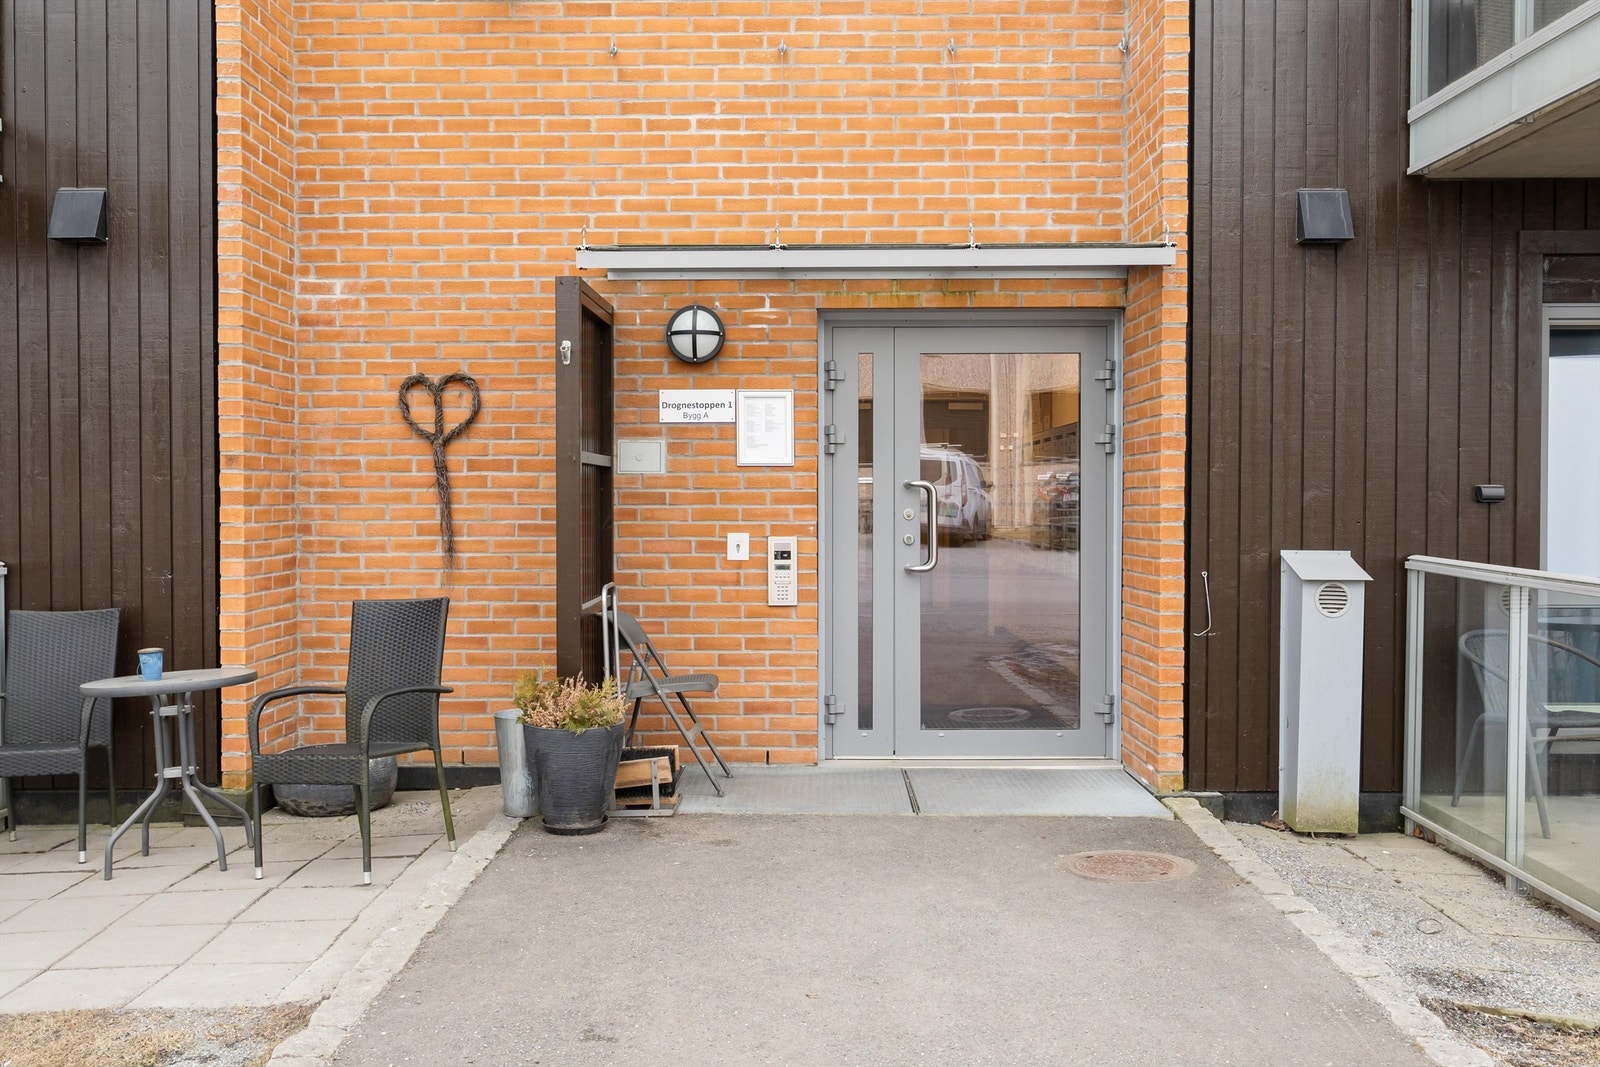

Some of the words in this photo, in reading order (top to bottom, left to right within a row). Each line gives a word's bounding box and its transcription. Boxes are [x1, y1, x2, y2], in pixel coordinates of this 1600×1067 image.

[661, 401, 726, 411] Drognestoppen
[727, 401, 733, 409] 1
[682, 411, 702, 420] Bygg
[703, 411, 709, 419] A
